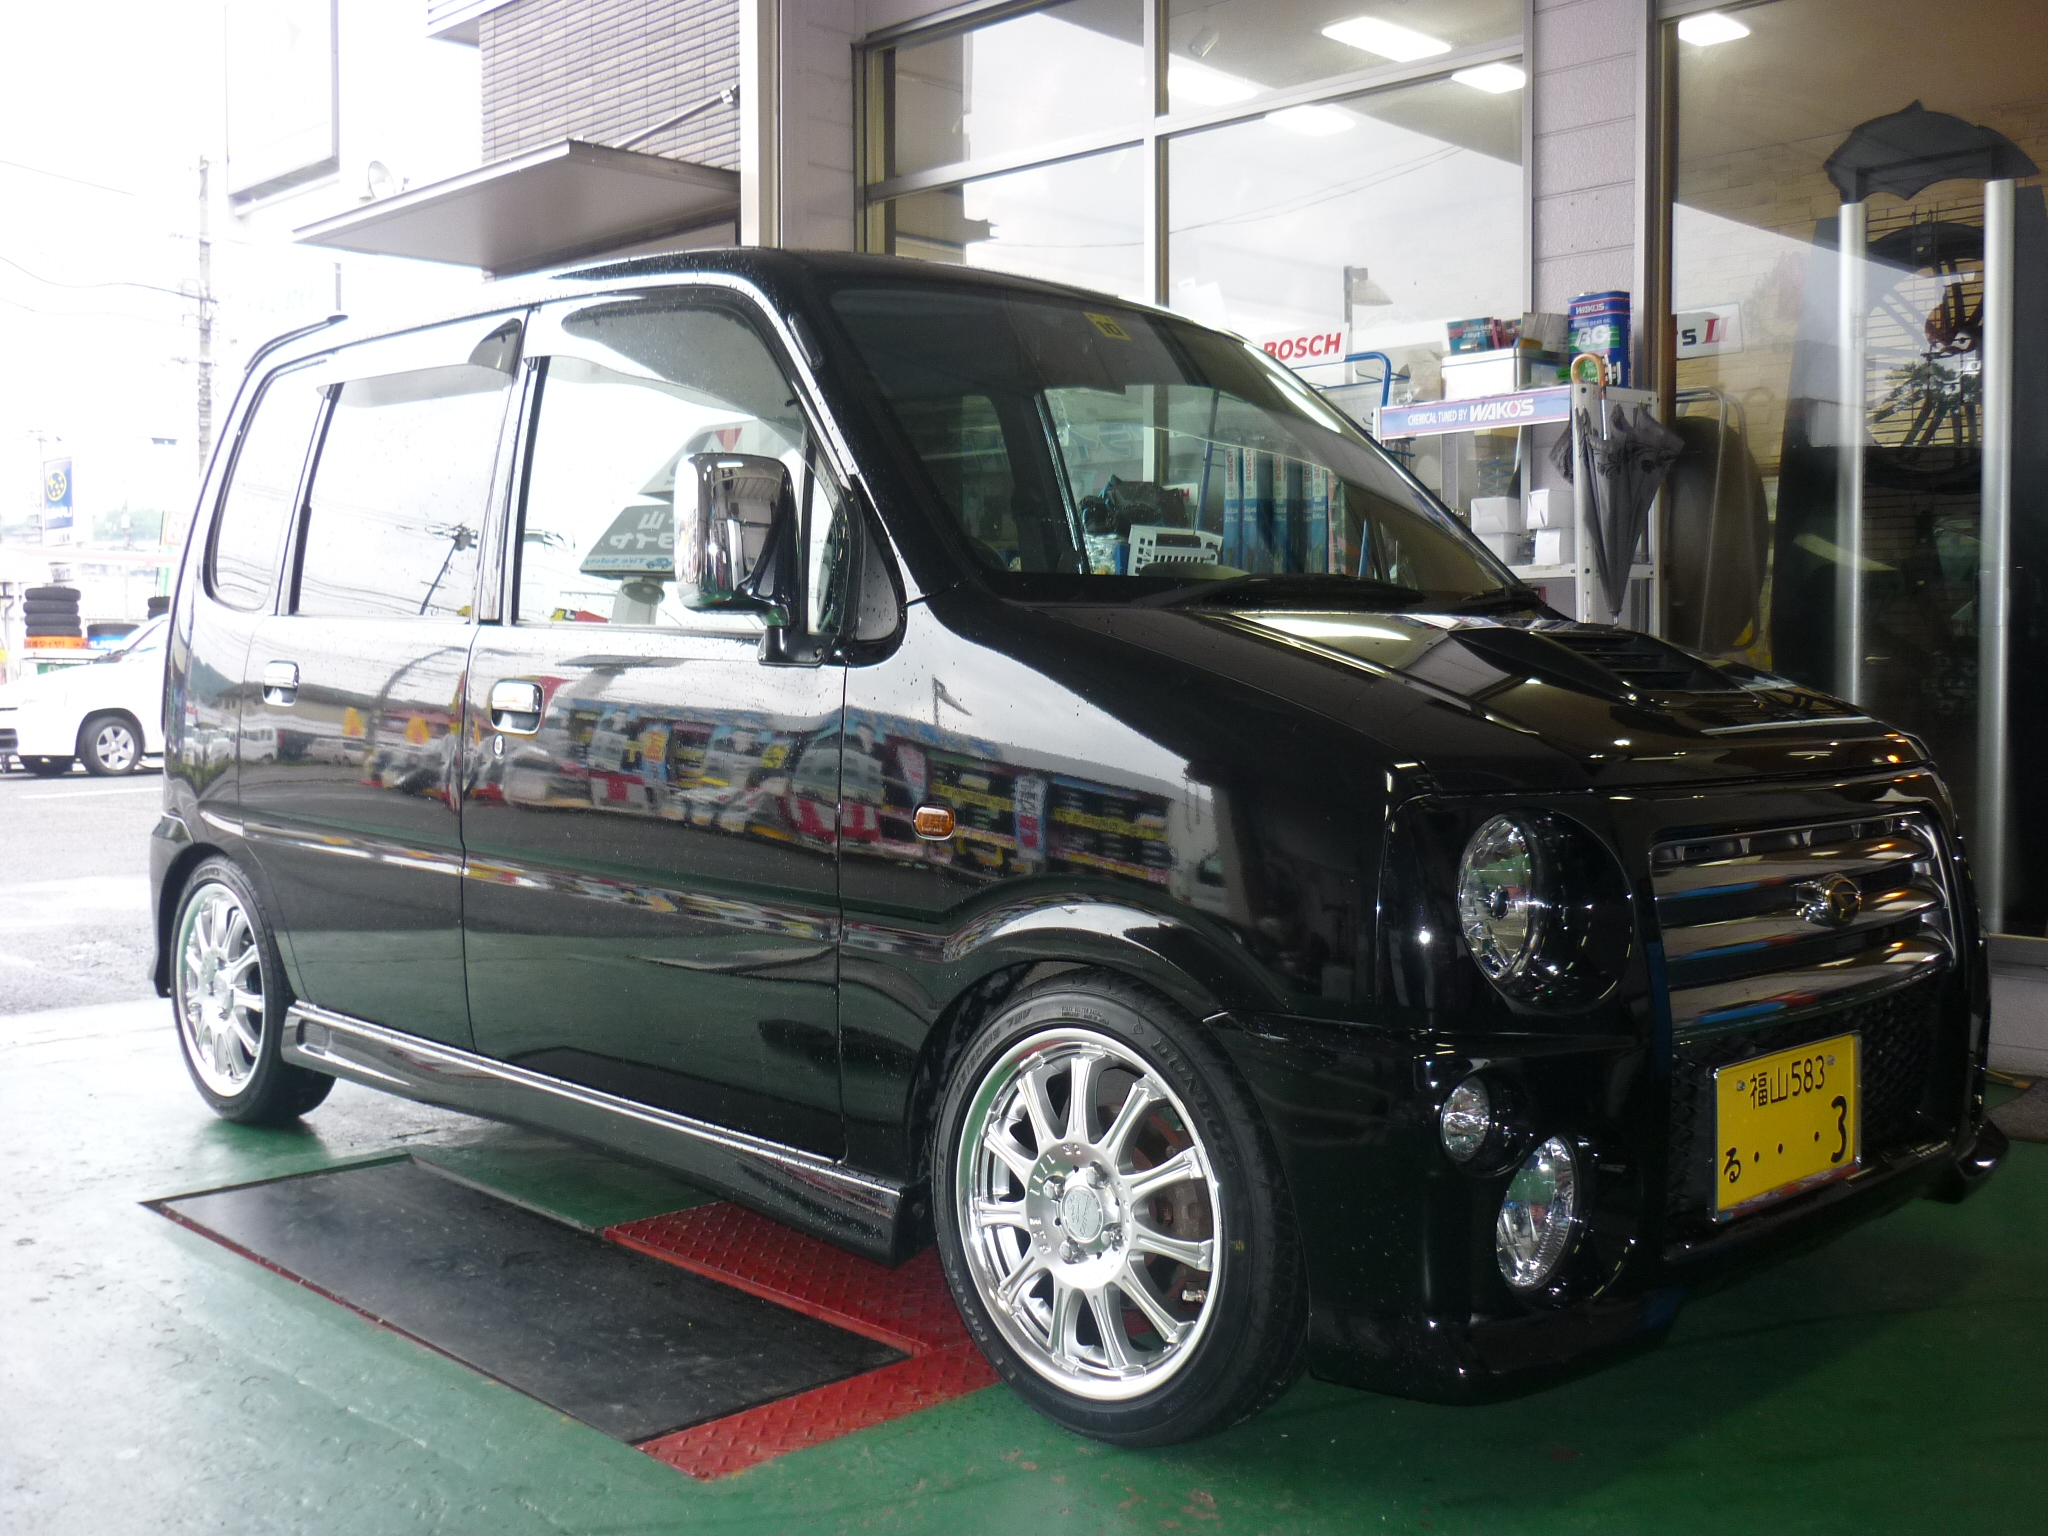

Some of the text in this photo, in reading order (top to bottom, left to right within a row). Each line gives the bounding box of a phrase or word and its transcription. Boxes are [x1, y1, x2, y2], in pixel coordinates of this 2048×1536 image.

[1263, 332, 1342, 360] BOSCH
[1407, 412, 1437, 426] CHEMICAL
[1438, 409, 1457, 423] TUNED
[1457, 408, 1467, 421] BY
[1226, 451, 1234, 482] BOSCH
